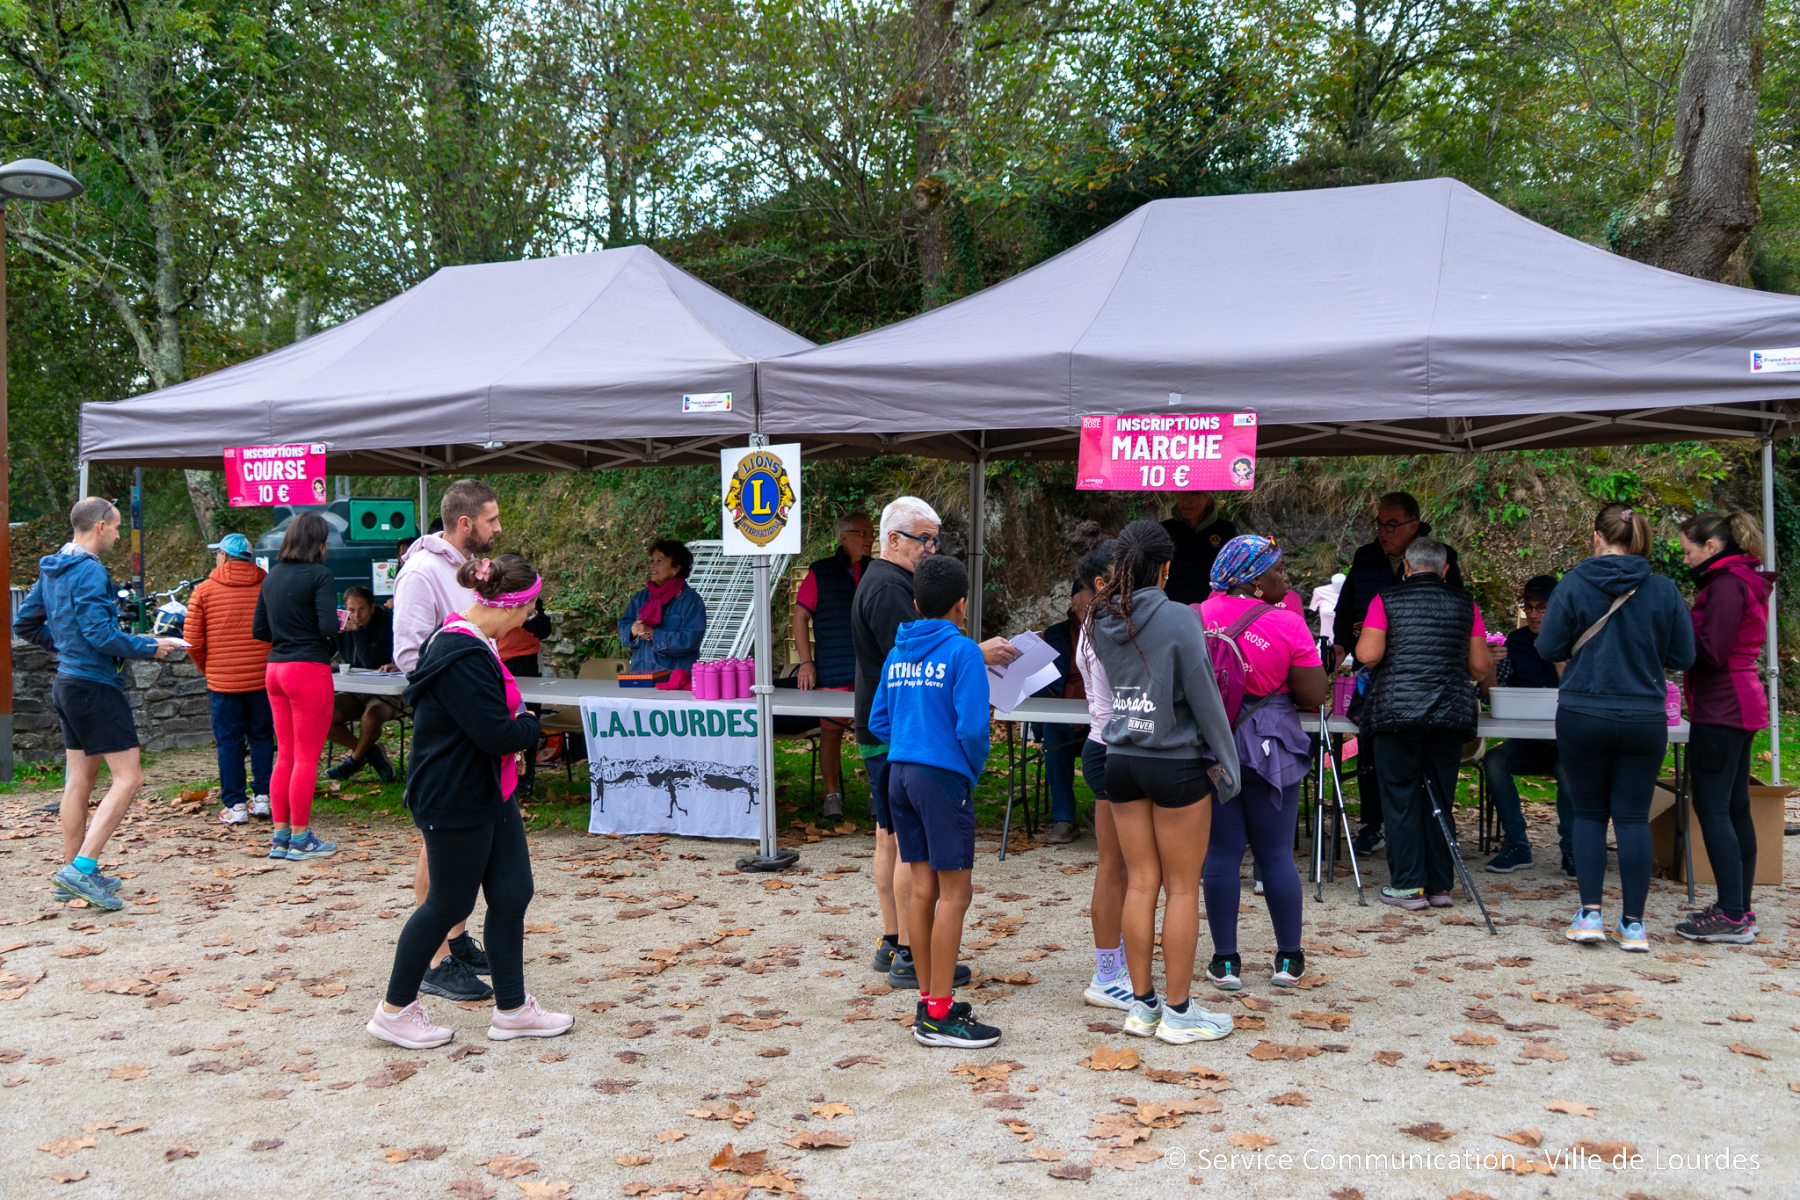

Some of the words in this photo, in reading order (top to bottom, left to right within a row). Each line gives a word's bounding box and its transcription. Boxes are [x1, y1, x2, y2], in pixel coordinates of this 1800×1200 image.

[1083, 420, 1101, 429] ROSE
[1116, 416, 1221, 432] INSCRIPTIONS
[243, 446, 304, 460] INSCRIPTIONS
[1111, 434, 1223, 461] MARCHE
[243, 459, 307, 482] COURSE
[742, 455, 780, 474] LIONS
[1139, 464, 1166, 487] 10
[1172, 464, 1191, 487] €
[258, 484, 274, 503] 10
[277, 484, 290, 503] €
[750, 479, 772, 515] L
[739, 519, 783, 538] INTERNATIONAL
[1244, 630, 1271, 651] ROSE
[924, 660, 947, 680] 65
[1112, 691, 1157, 713] olorado
[1129, 718, 1154, 731] DENVER
